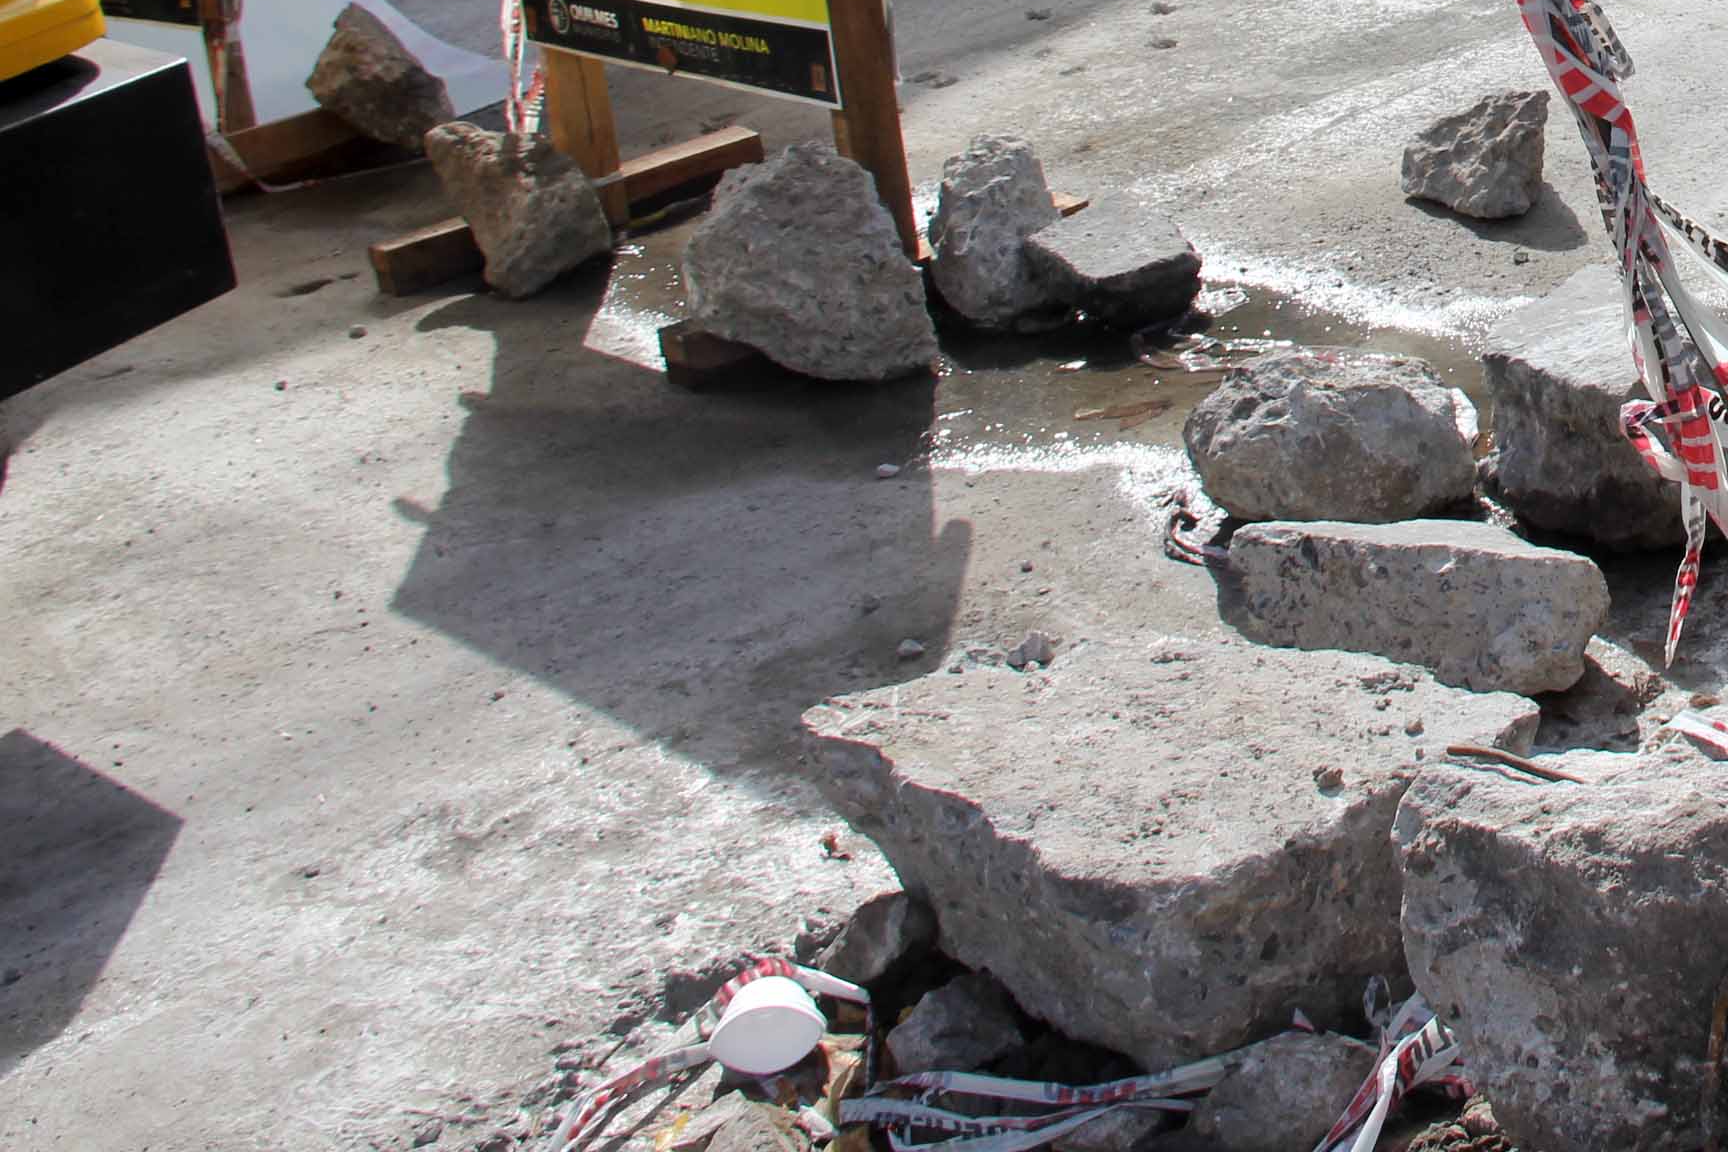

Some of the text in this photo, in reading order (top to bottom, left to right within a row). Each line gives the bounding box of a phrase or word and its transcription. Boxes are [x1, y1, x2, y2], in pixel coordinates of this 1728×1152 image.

[568, 2, 620, 29] QUILMES
[641, 15, 716, 46] MARTINIANO
[718, 28, 770, 55] MOLINA
